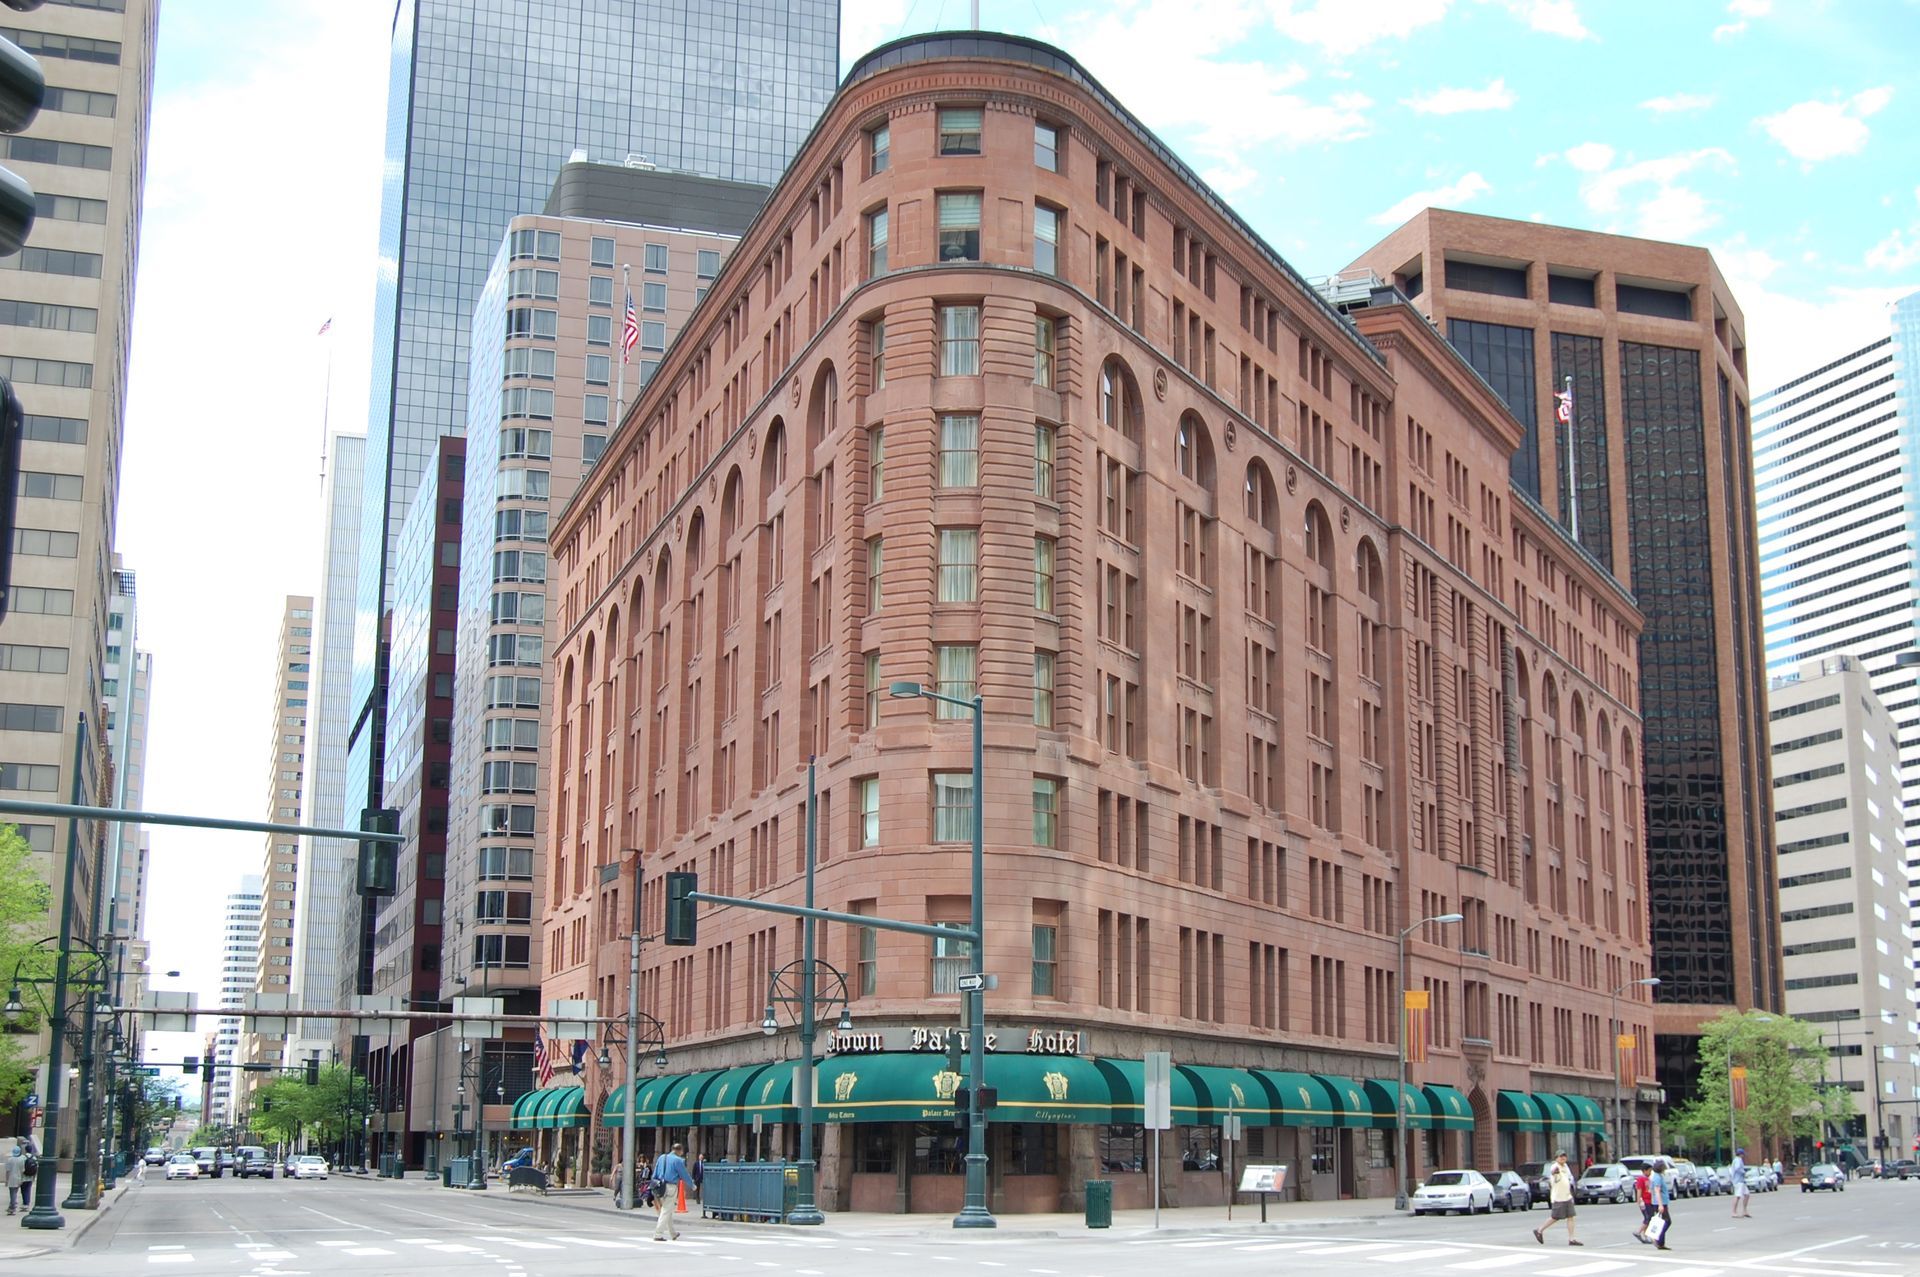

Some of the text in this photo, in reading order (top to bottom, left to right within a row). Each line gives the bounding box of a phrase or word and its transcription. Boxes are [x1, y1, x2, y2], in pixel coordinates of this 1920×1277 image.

[827, 1027, 1081, 1054] Brown Palae Hotel
